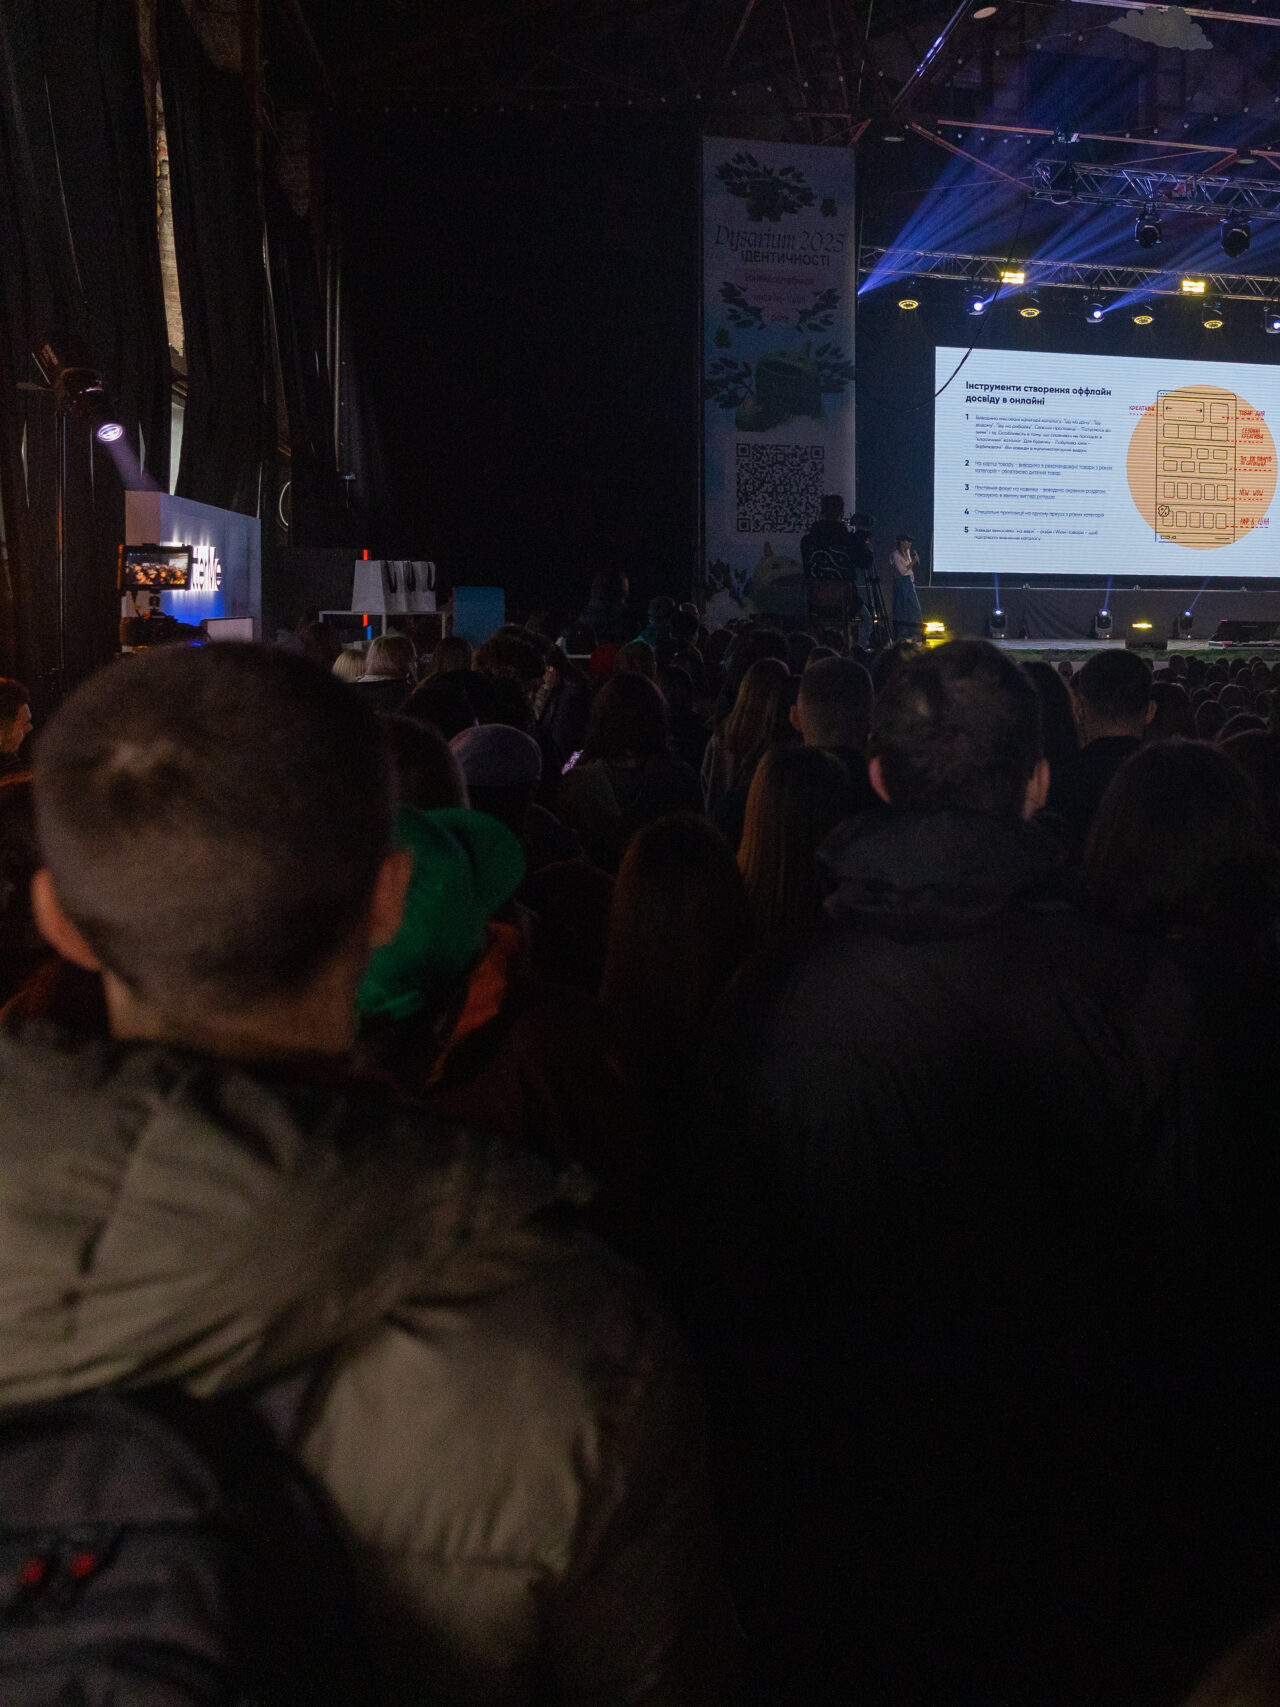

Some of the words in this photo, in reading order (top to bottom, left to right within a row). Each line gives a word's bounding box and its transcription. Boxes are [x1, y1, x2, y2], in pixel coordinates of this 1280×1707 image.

[715, 224, 796, 252] Dysarium
[800, 230, 846, 252] 2025
[741, 250, 830, 266] ІДЕНТИЧНОСТІ
[965, 381, 1022, 392] Інструменти
[1023, 385, 1070, 395] створення
[1072, 387, 1112, 397] оффлайн
[965, 394, 1000, 405] досвіду
[1002, 396, 1008, 404] в
[1009, 396, 1045, 405] онлайні
[965, 459, 970, 467] 2
[965, 483, 970, 491] 3
[964, 508, 970, 516] 4
